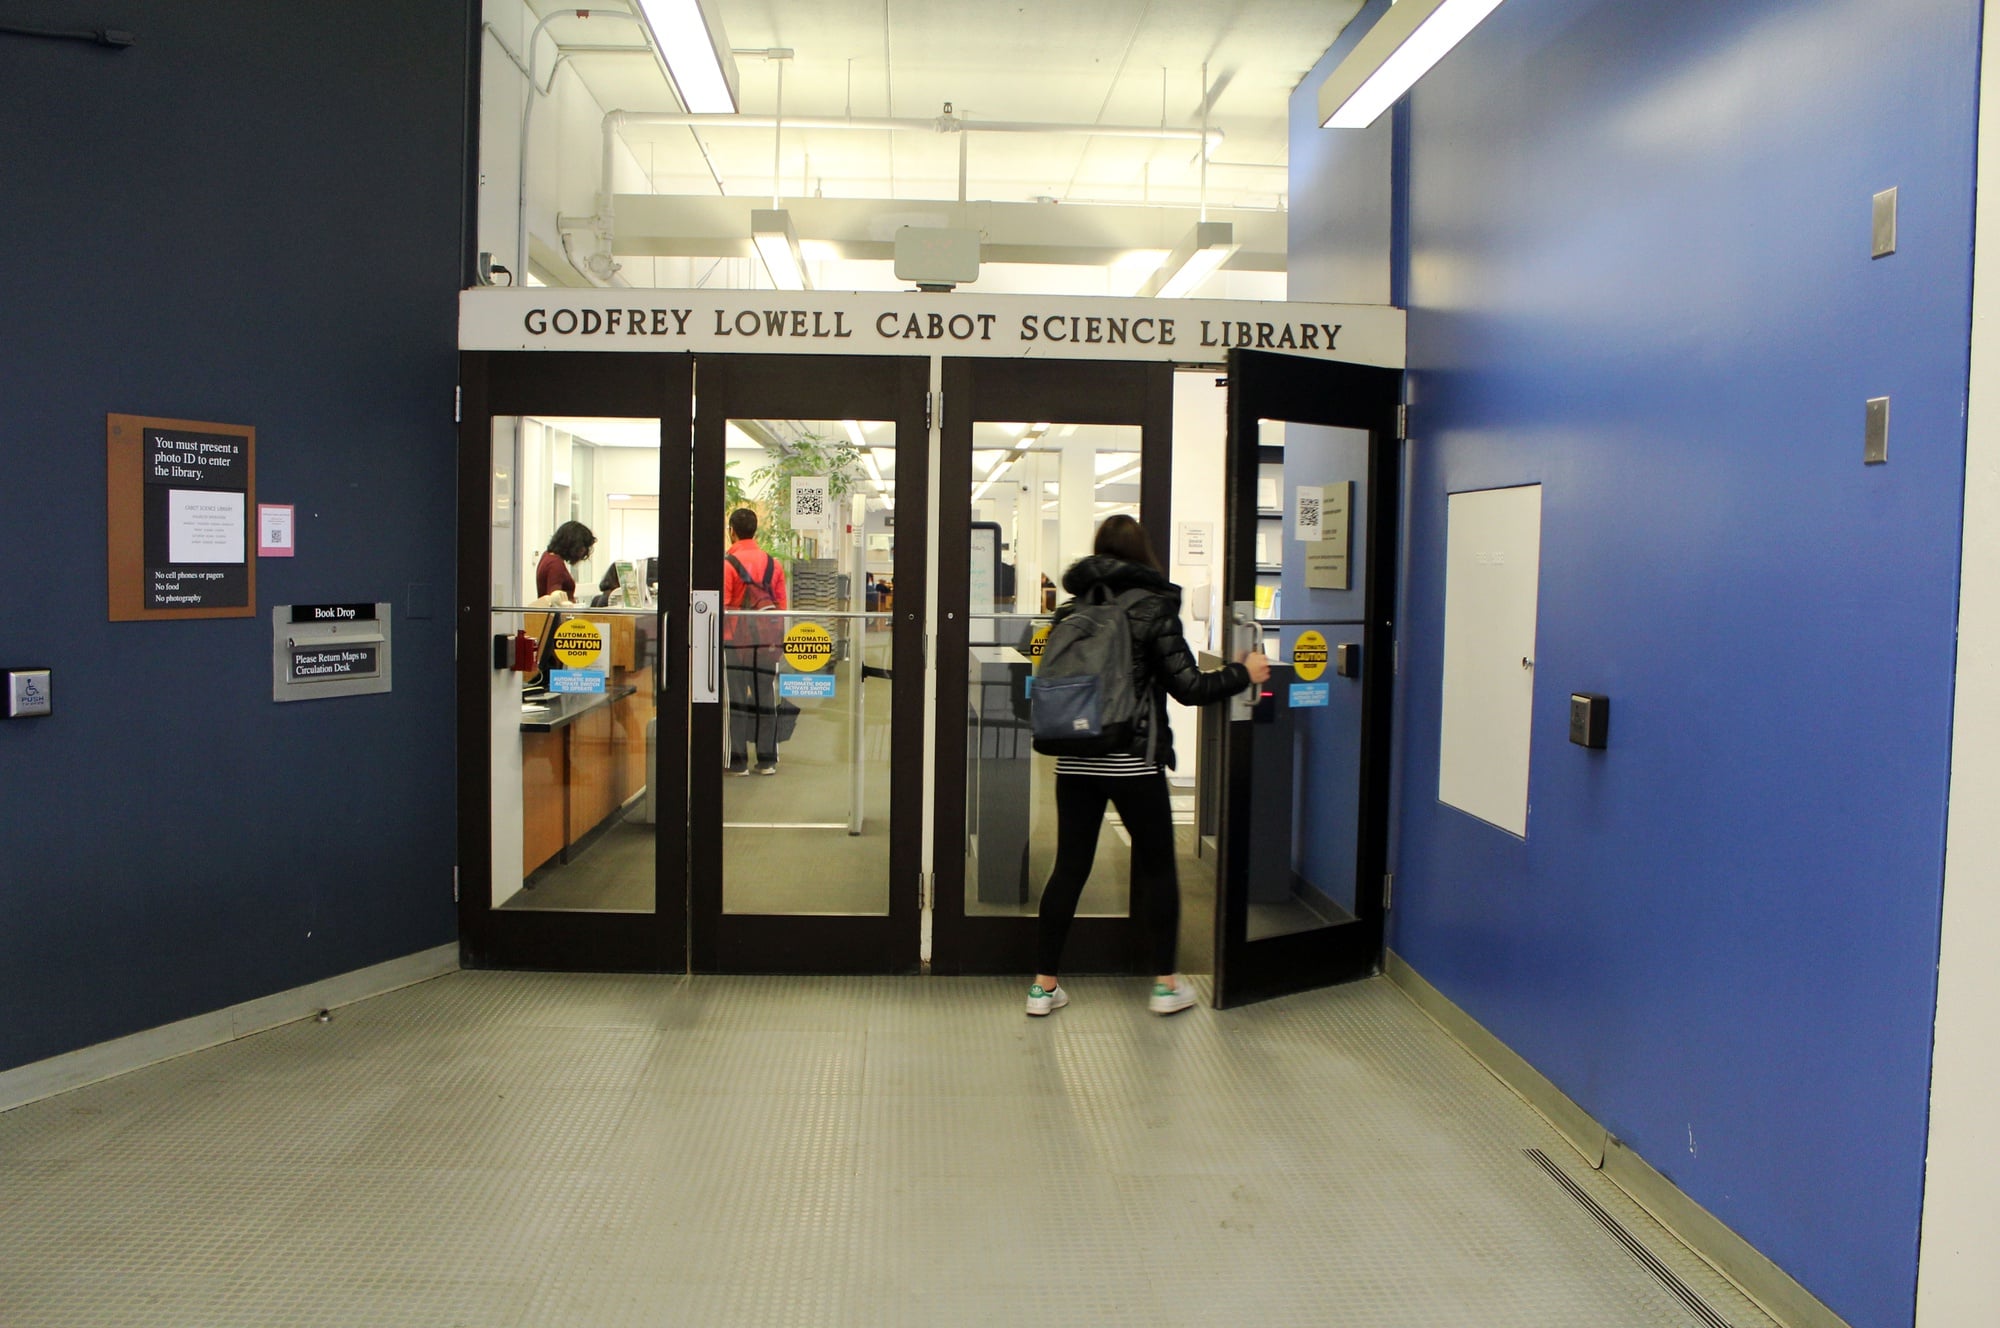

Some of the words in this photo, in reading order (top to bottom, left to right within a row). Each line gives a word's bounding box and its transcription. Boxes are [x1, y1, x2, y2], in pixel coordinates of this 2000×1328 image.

[524, 308, 693, 336] GODFREY
[714, 309, 852, 338] LOWELL
[875, 312, 996, 341] CABOT
[1020, 315, 1177, 345] SCIENCE
[1200, 320, 1343, 351] LIBRARY
[155, 436, 174, 449] You
[175, 440, 198, 451] must
[199, 442, 231, 454] present
[233, 446, 239, 454] a
[154, 451, 181, 465] photo
[183, 453, 196, 464] ID
[198, 455, 207, 465] to
[208, 457, 231, 467] enter
[154, 465, 169, 476] the
[171, 466, 204, 480] library.
[177, 572, 198, 580] phones
[166, 594, 201, 603] photography
[315, 608, 335, 618] Book
[337, 607, 355, 619] Drop
[556, 640, 600, 648] CAUTION
[786, 644, 830, 652] CAUTION
[295, 655, 317, 664] Please
[318, 653, 340, 662] Return
[341, 652, 359, 662] Maps
[1295, 652, 1326, 661] CAUTION
[295, 665, 333, 675] Circulation
[334, 663, 351, 672] Desk
